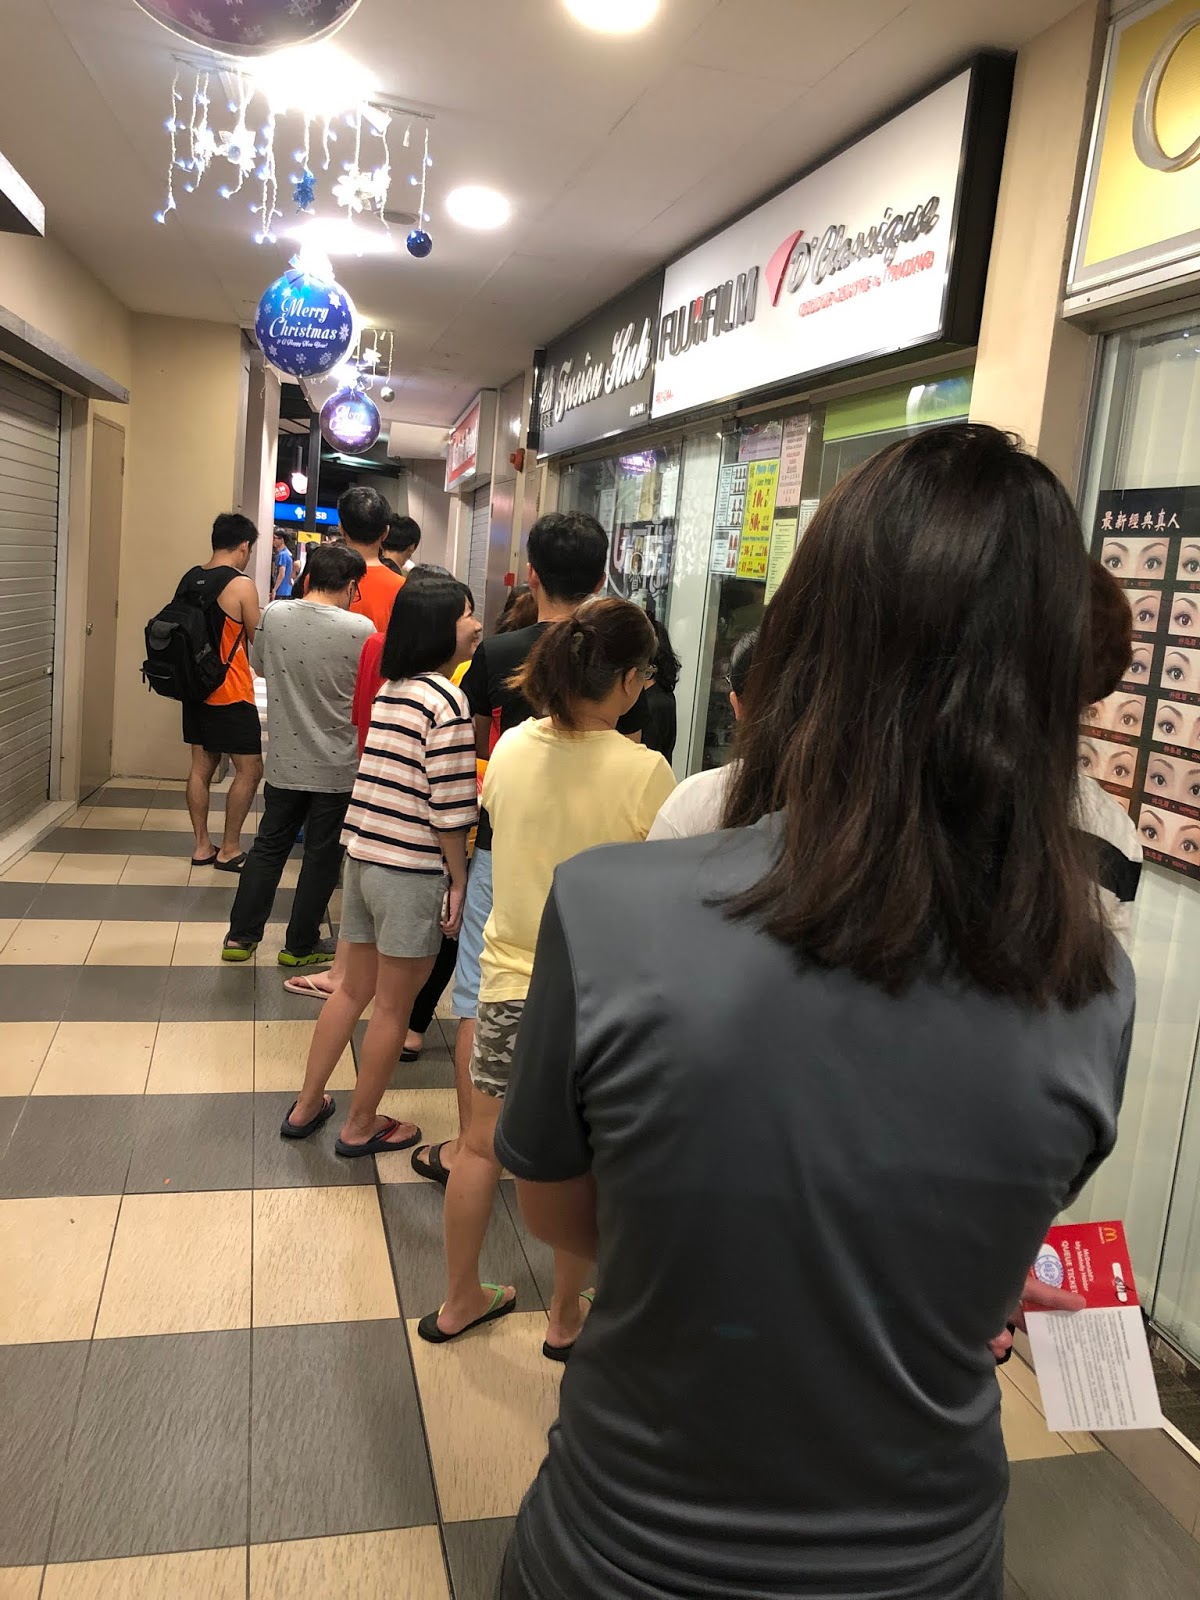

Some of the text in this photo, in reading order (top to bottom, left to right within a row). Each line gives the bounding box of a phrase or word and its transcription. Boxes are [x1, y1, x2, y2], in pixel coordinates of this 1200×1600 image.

[281, 296, 330, 323] Merry
[659, 265, 760, 362] FUJIFILM
[269, 316, 338, 340] Christmas
[1101, 508, 1181, 532] 最新經典真人
[1061, 1240, 1079, 1294] QUEUE TICKET
